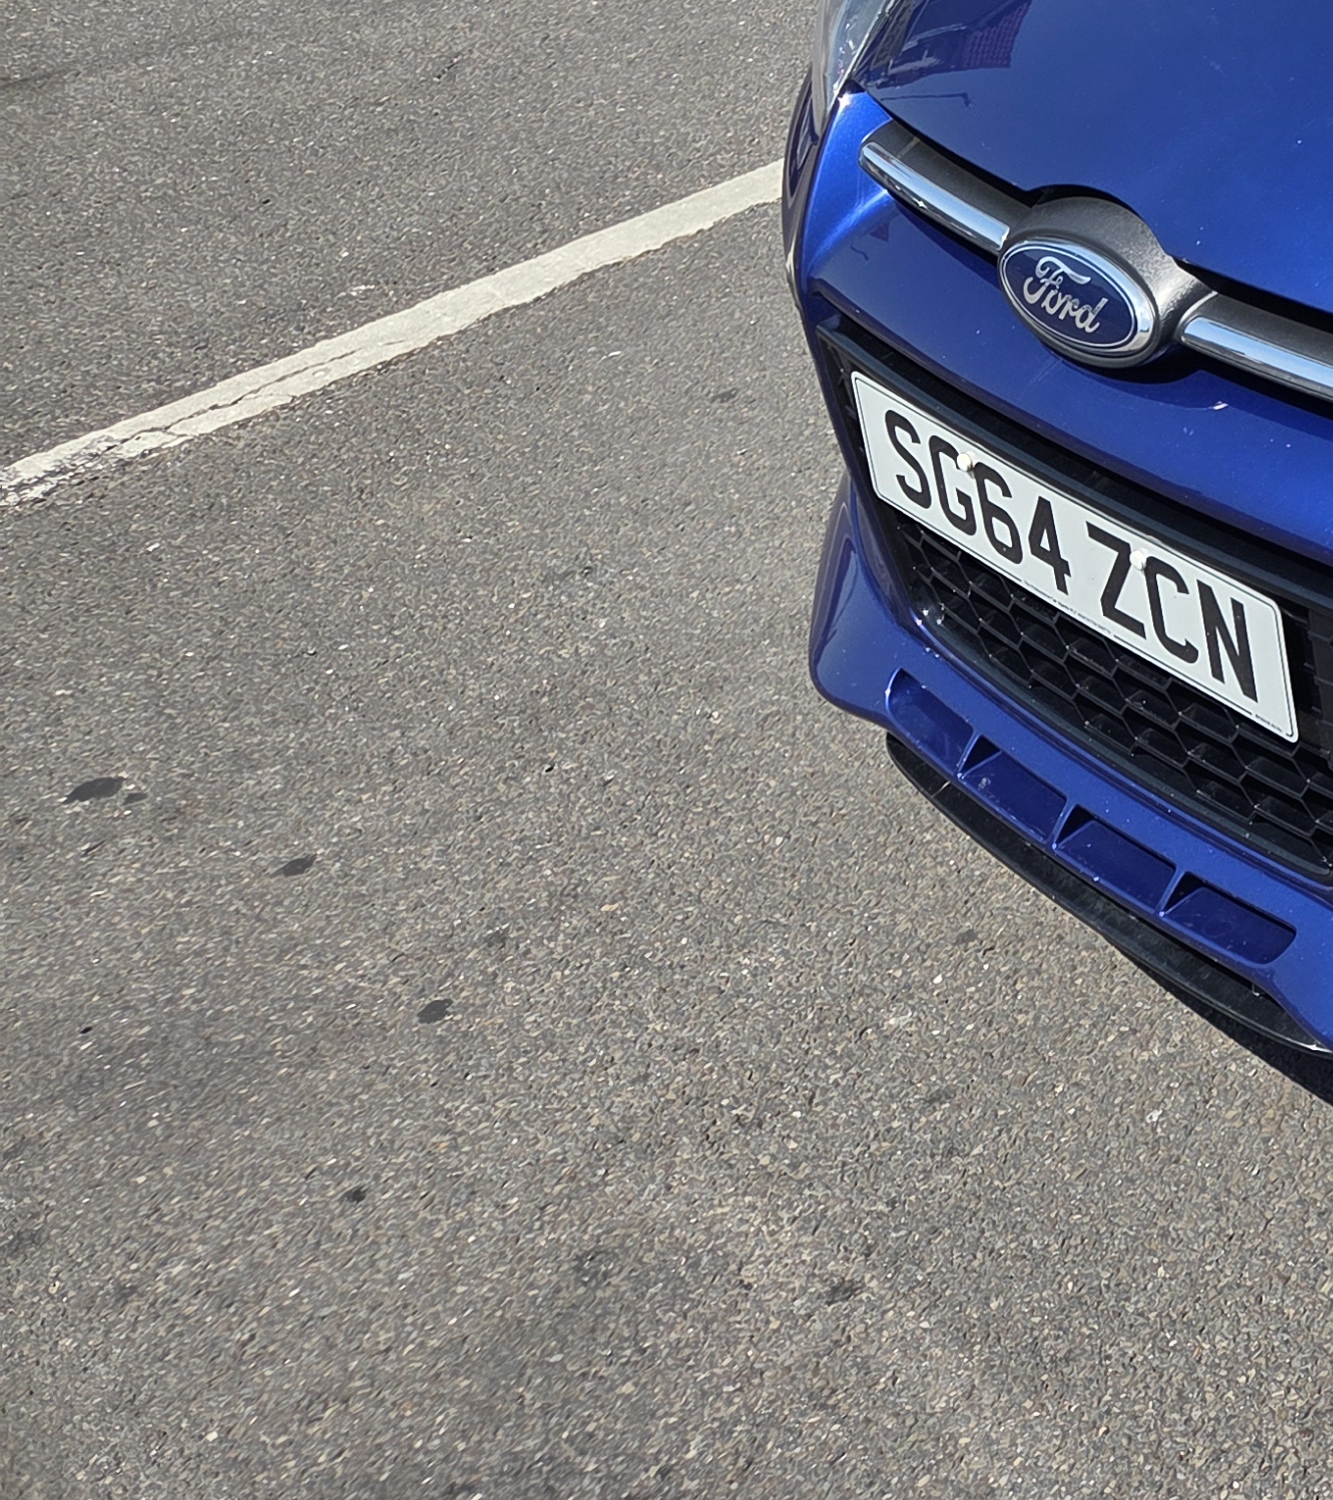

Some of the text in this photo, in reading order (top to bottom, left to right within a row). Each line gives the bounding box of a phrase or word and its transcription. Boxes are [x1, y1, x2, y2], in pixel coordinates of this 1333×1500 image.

[1023, 256, 1109, 333] Ford
[884, 408, 1259, 703] SG64 ZCN
